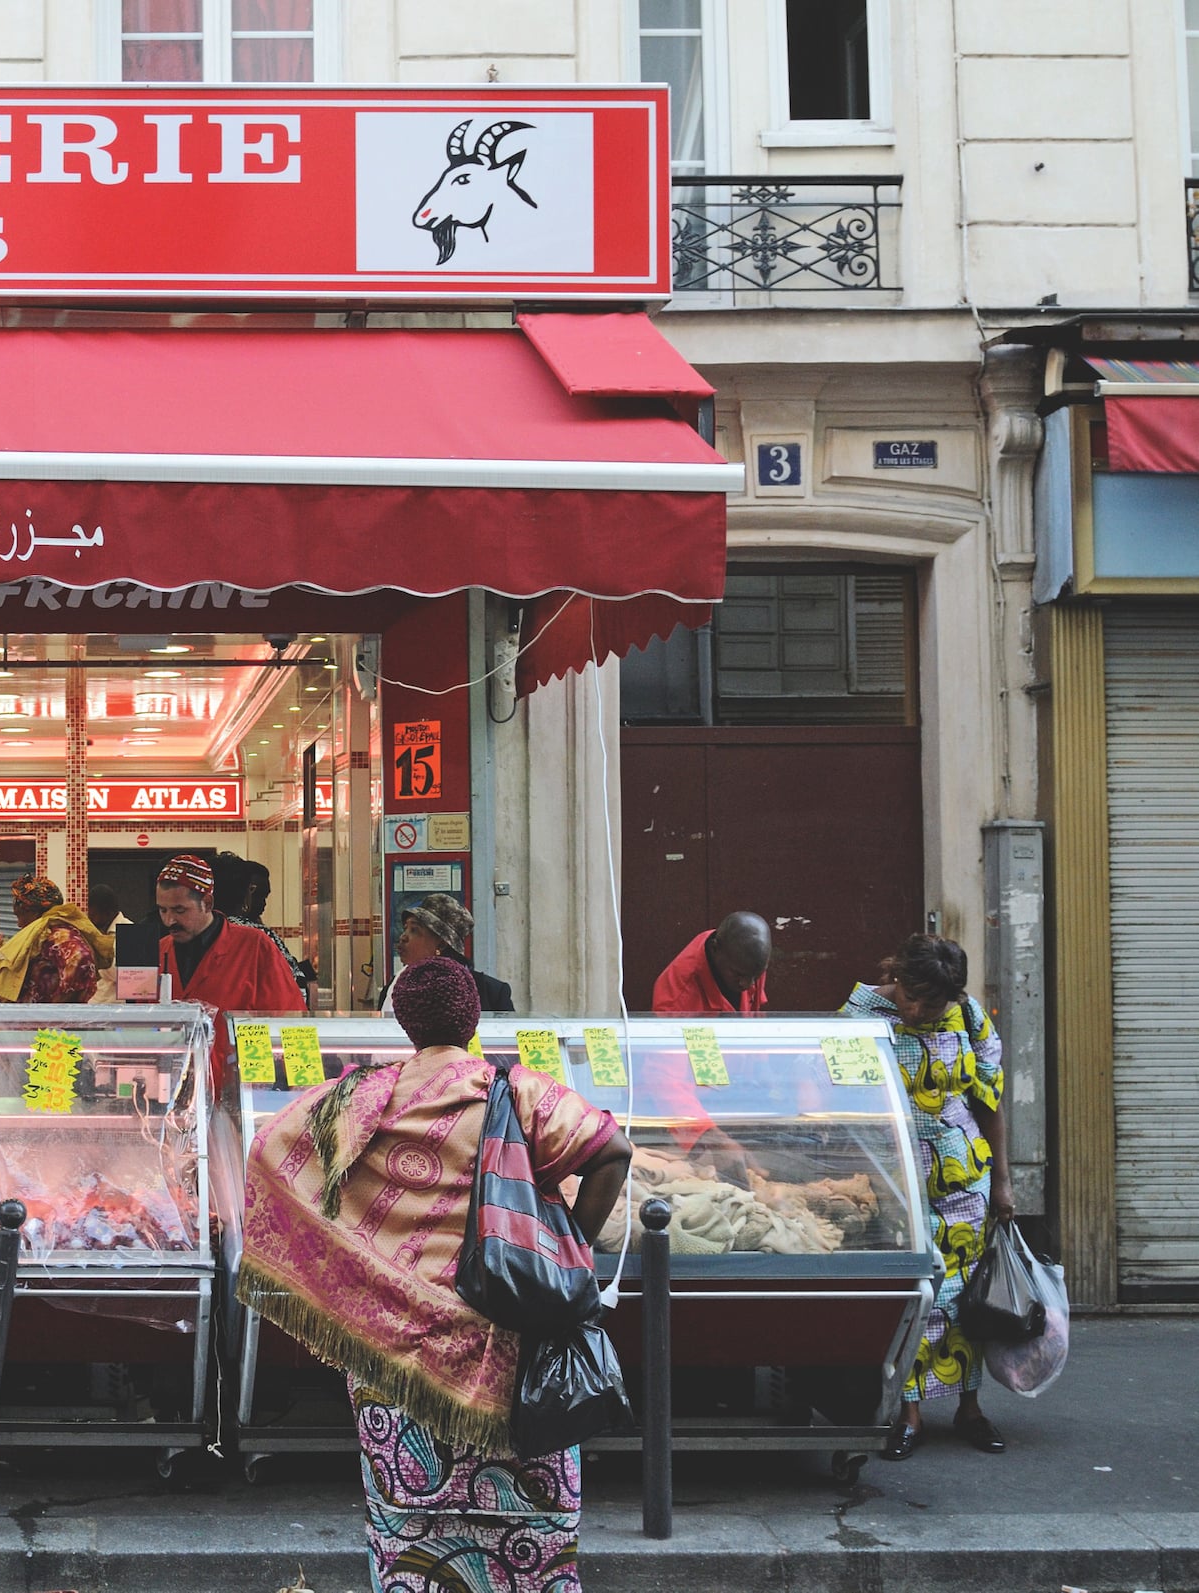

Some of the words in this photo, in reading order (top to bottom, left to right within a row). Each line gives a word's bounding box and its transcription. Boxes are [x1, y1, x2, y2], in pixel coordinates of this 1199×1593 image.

[890, 443, 920, 455] GAZ
[770, 446, 791, 482] 3
[396, 745, 435, 797] 15
[131, 787, 227, 810] ATLAS
